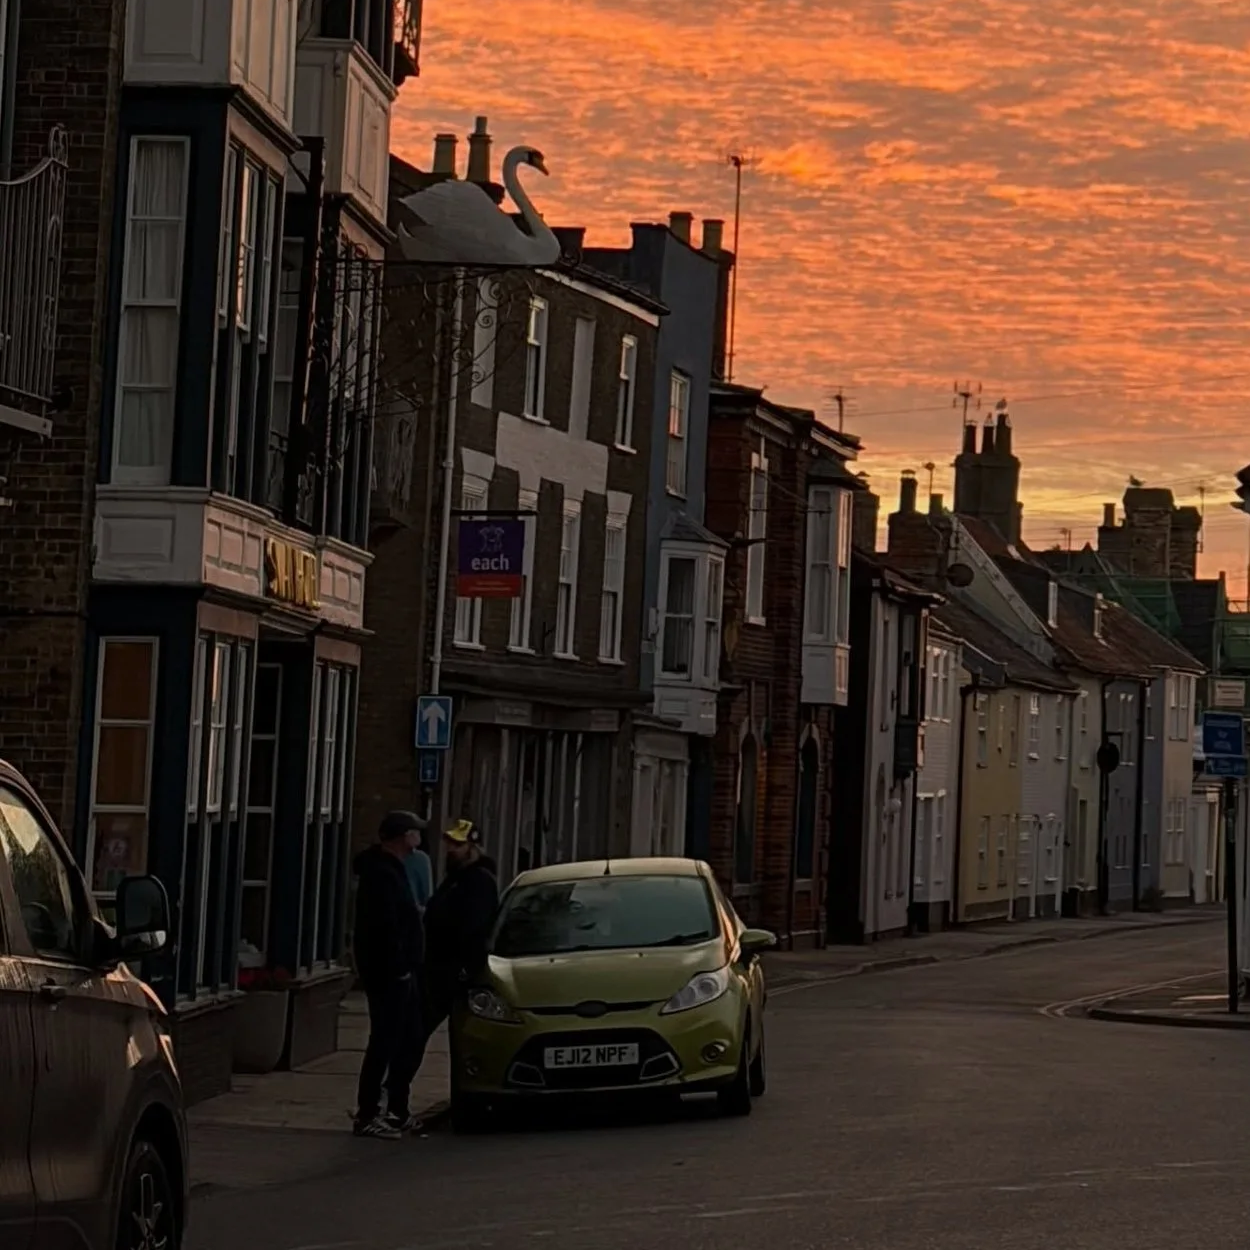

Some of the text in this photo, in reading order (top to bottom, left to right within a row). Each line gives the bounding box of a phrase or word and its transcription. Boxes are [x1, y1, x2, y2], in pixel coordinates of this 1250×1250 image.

[471, 553, 510, 571] each
[555, 1046, 629, 1065] EJ12 NPF
